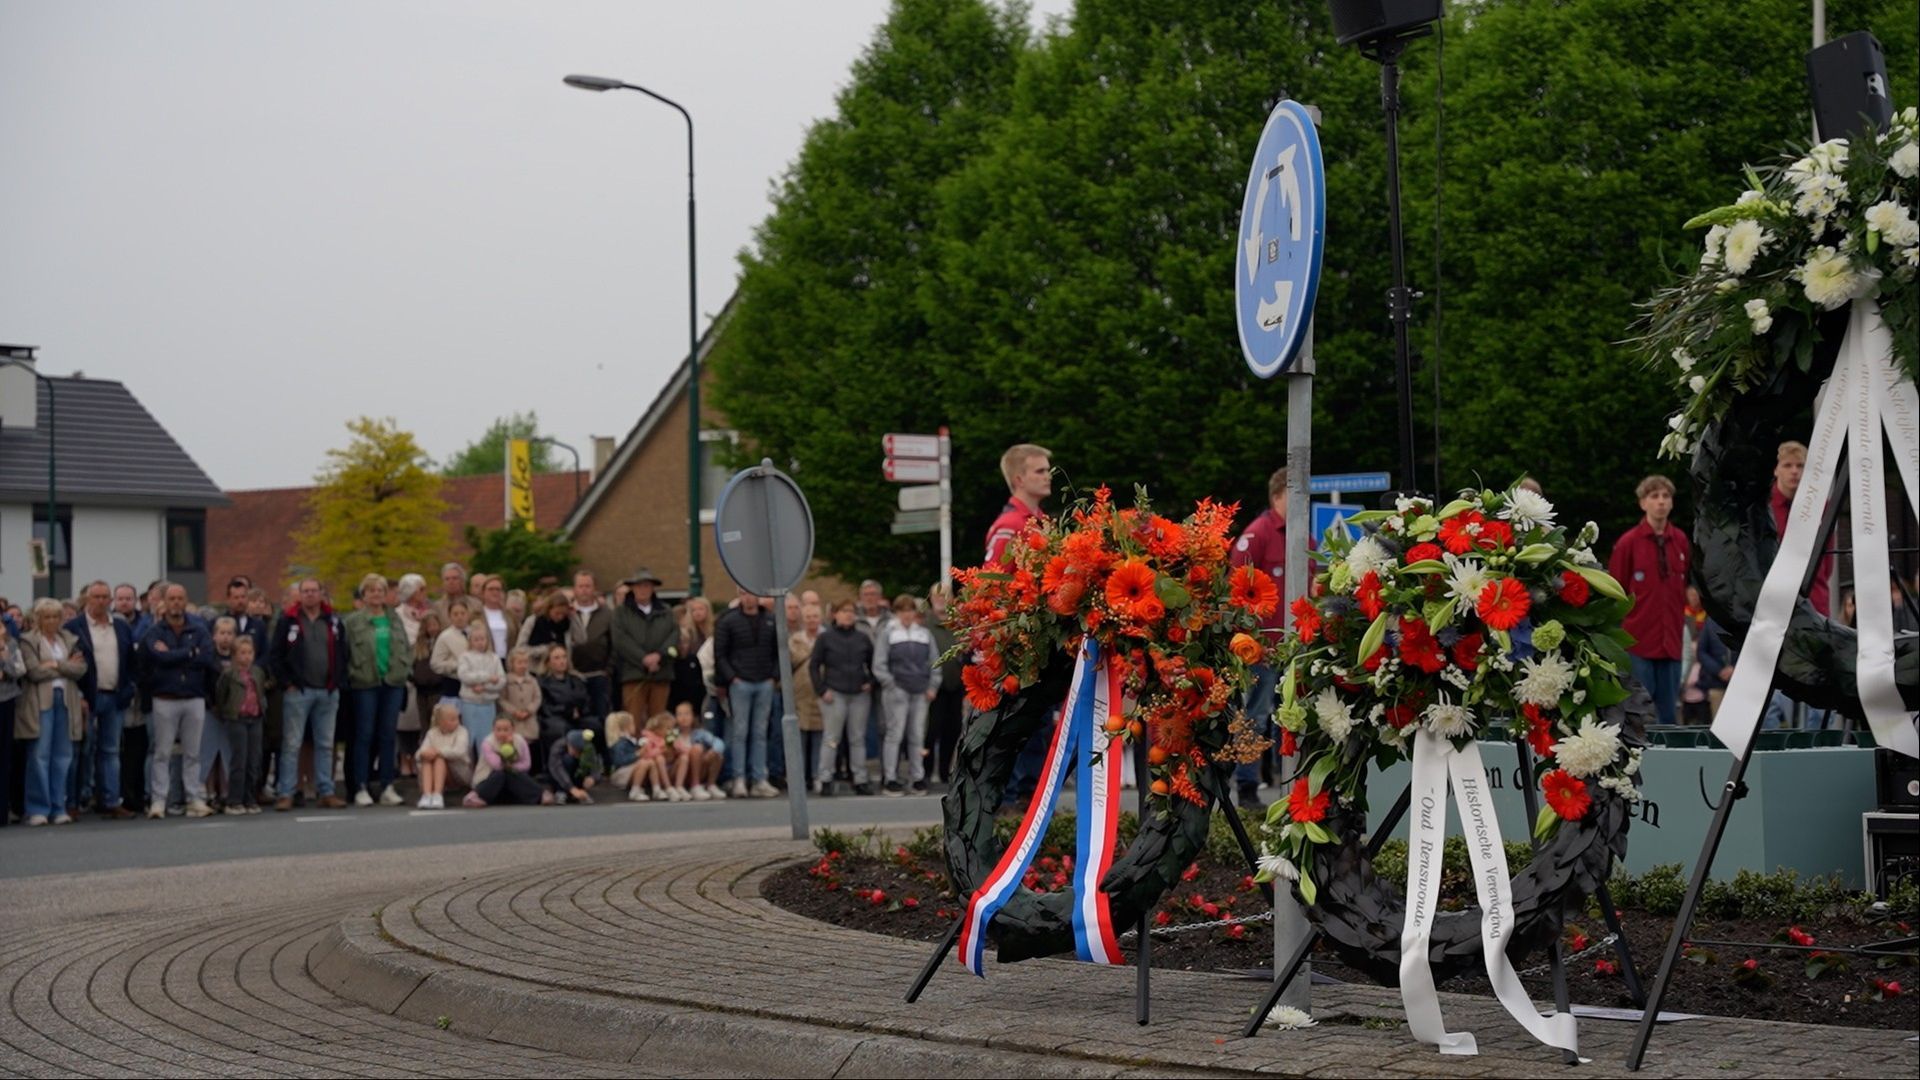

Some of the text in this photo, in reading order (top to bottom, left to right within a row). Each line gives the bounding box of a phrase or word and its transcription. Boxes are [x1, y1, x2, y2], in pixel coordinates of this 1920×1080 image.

[1800, 485, 1818, 522] Kerk
[1094, 698, 1108, 808] Rensoude
[1413, 840, 1434, 927] Renswoude
[1462, 778, 1492, 860] Historische
[1485, 867, 1504, 939] Vereniging
